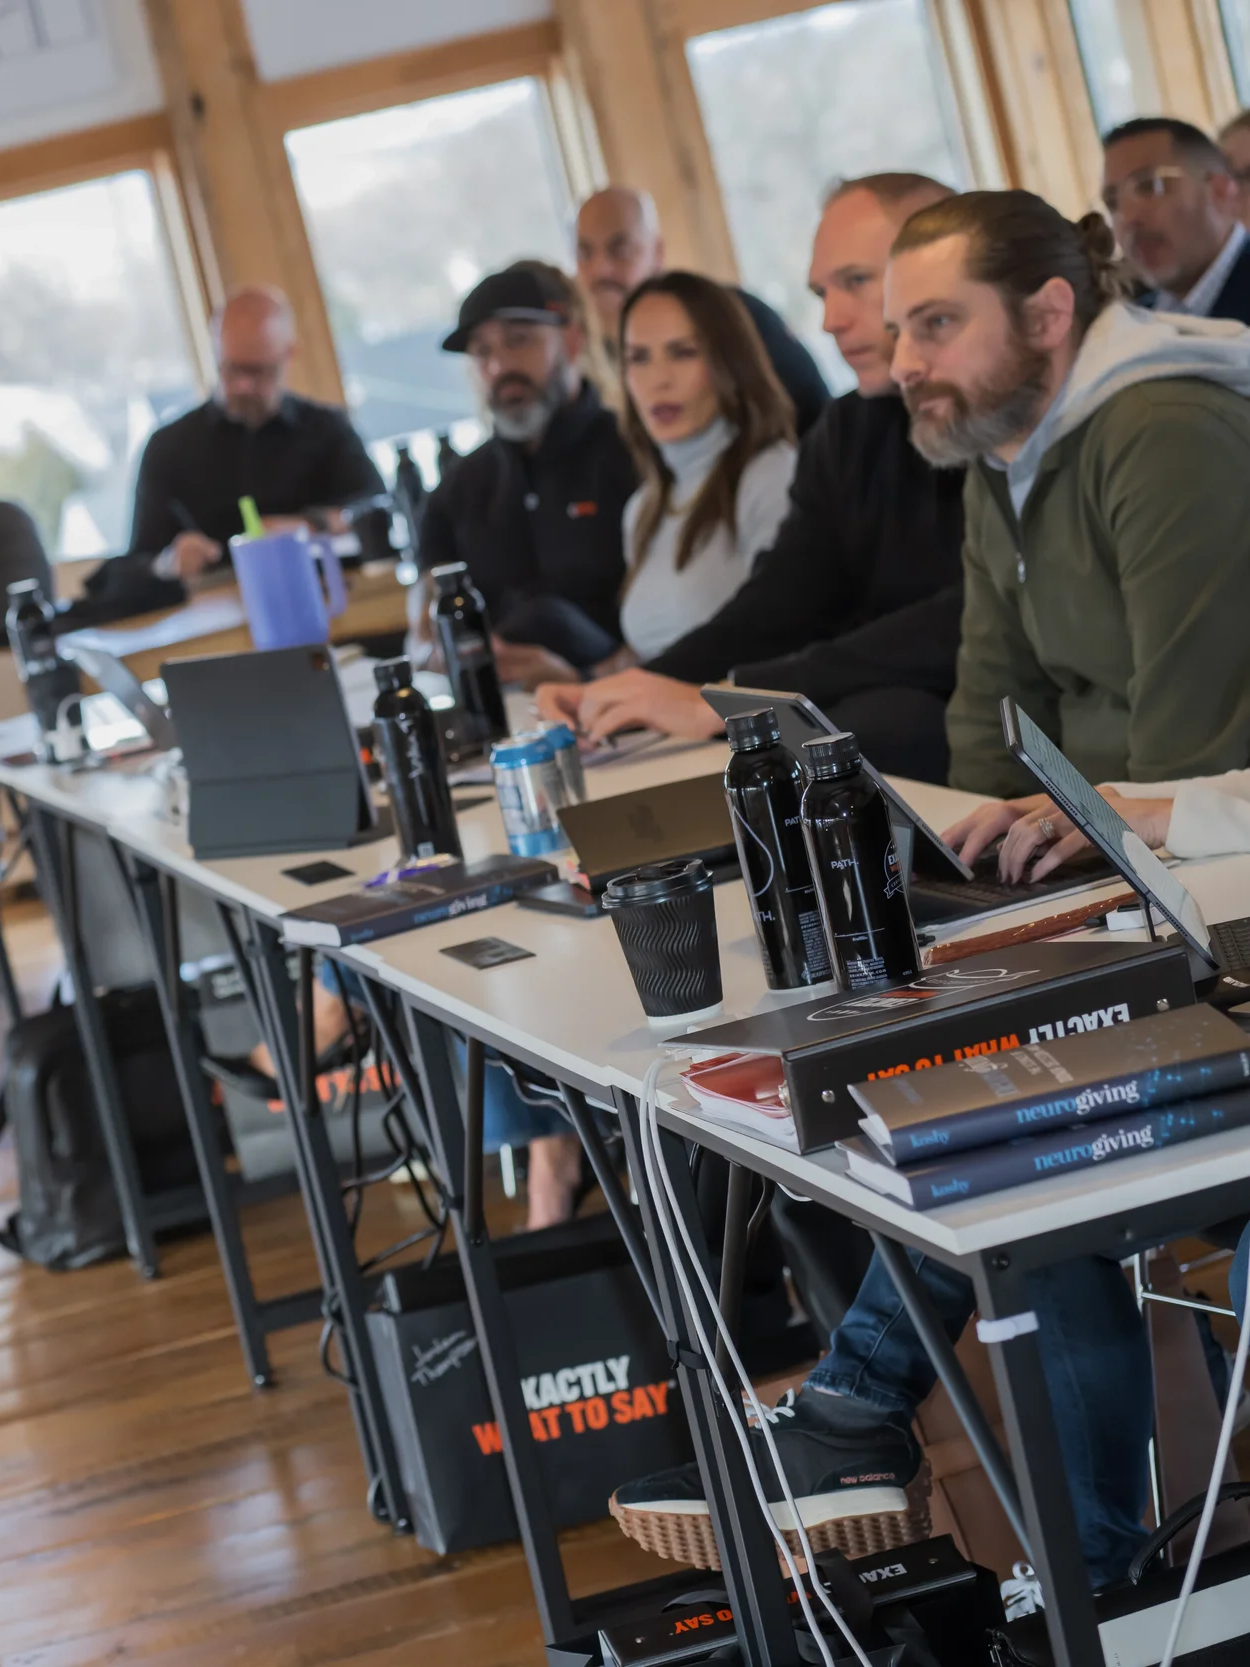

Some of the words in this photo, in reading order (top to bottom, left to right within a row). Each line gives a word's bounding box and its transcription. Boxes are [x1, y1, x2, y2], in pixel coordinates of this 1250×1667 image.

[784, 815, 804, 828] PAT
[1015, 1079, 1141, 1124] neurogiving
[1033, 1124, 1153, 1171] neurogiving
[520, 1354, 631, 1411] XACTLY
[471, 1404, 561, 1456] WAT
[564, 1396, 609, 1435] TO
[611, 1381, 668, 1425] SAY
[840, 1476, 857, 1485] new
[859, 1472, 895, 1482] balance
[674, 1613, 714, 1636] SAY
[716, 1609, 733, 1622] O
